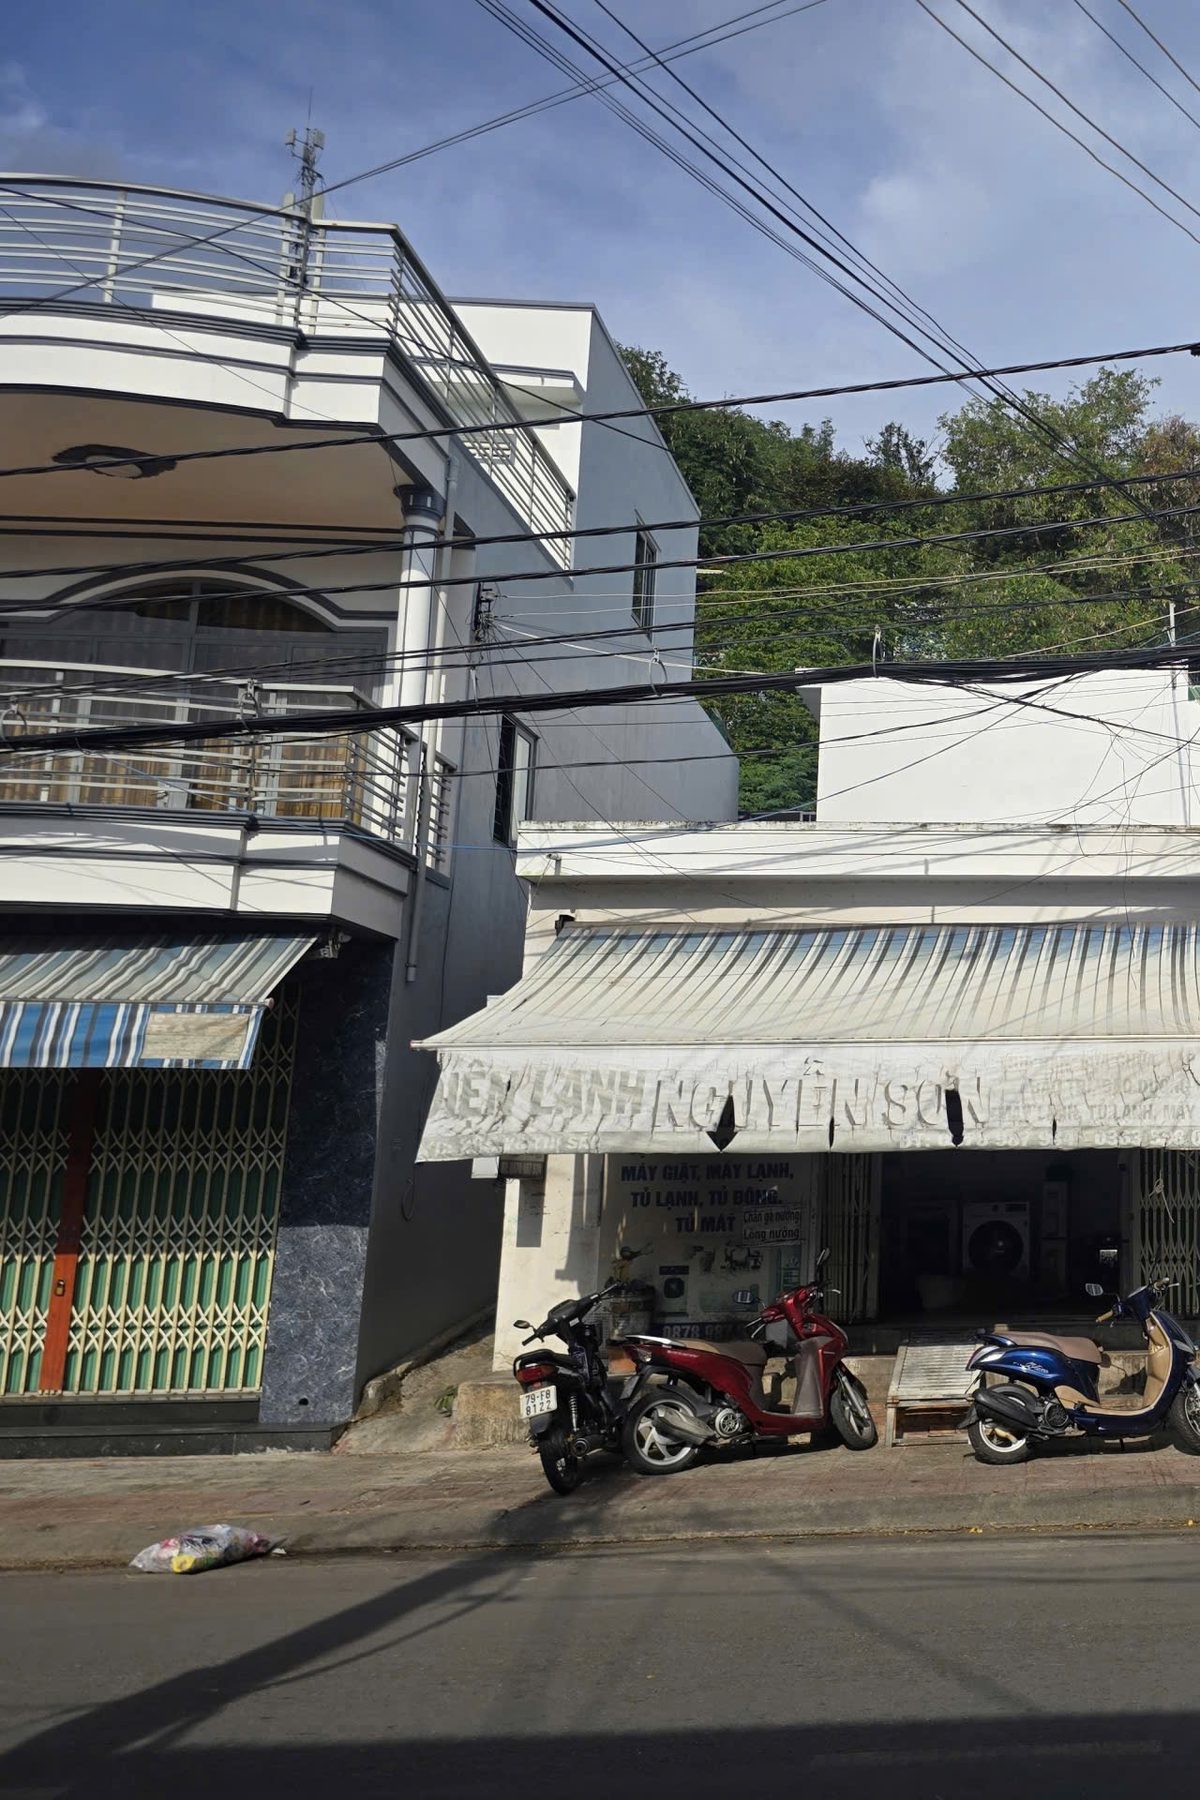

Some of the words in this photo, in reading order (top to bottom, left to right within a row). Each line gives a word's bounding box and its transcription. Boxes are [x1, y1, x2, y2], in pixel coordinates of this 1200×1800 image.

[621, 1162, 658, 1181] MÁY
[525, 1389, 551, 1405] 79-F8
[525, 1400, 552, 1416] 8122
